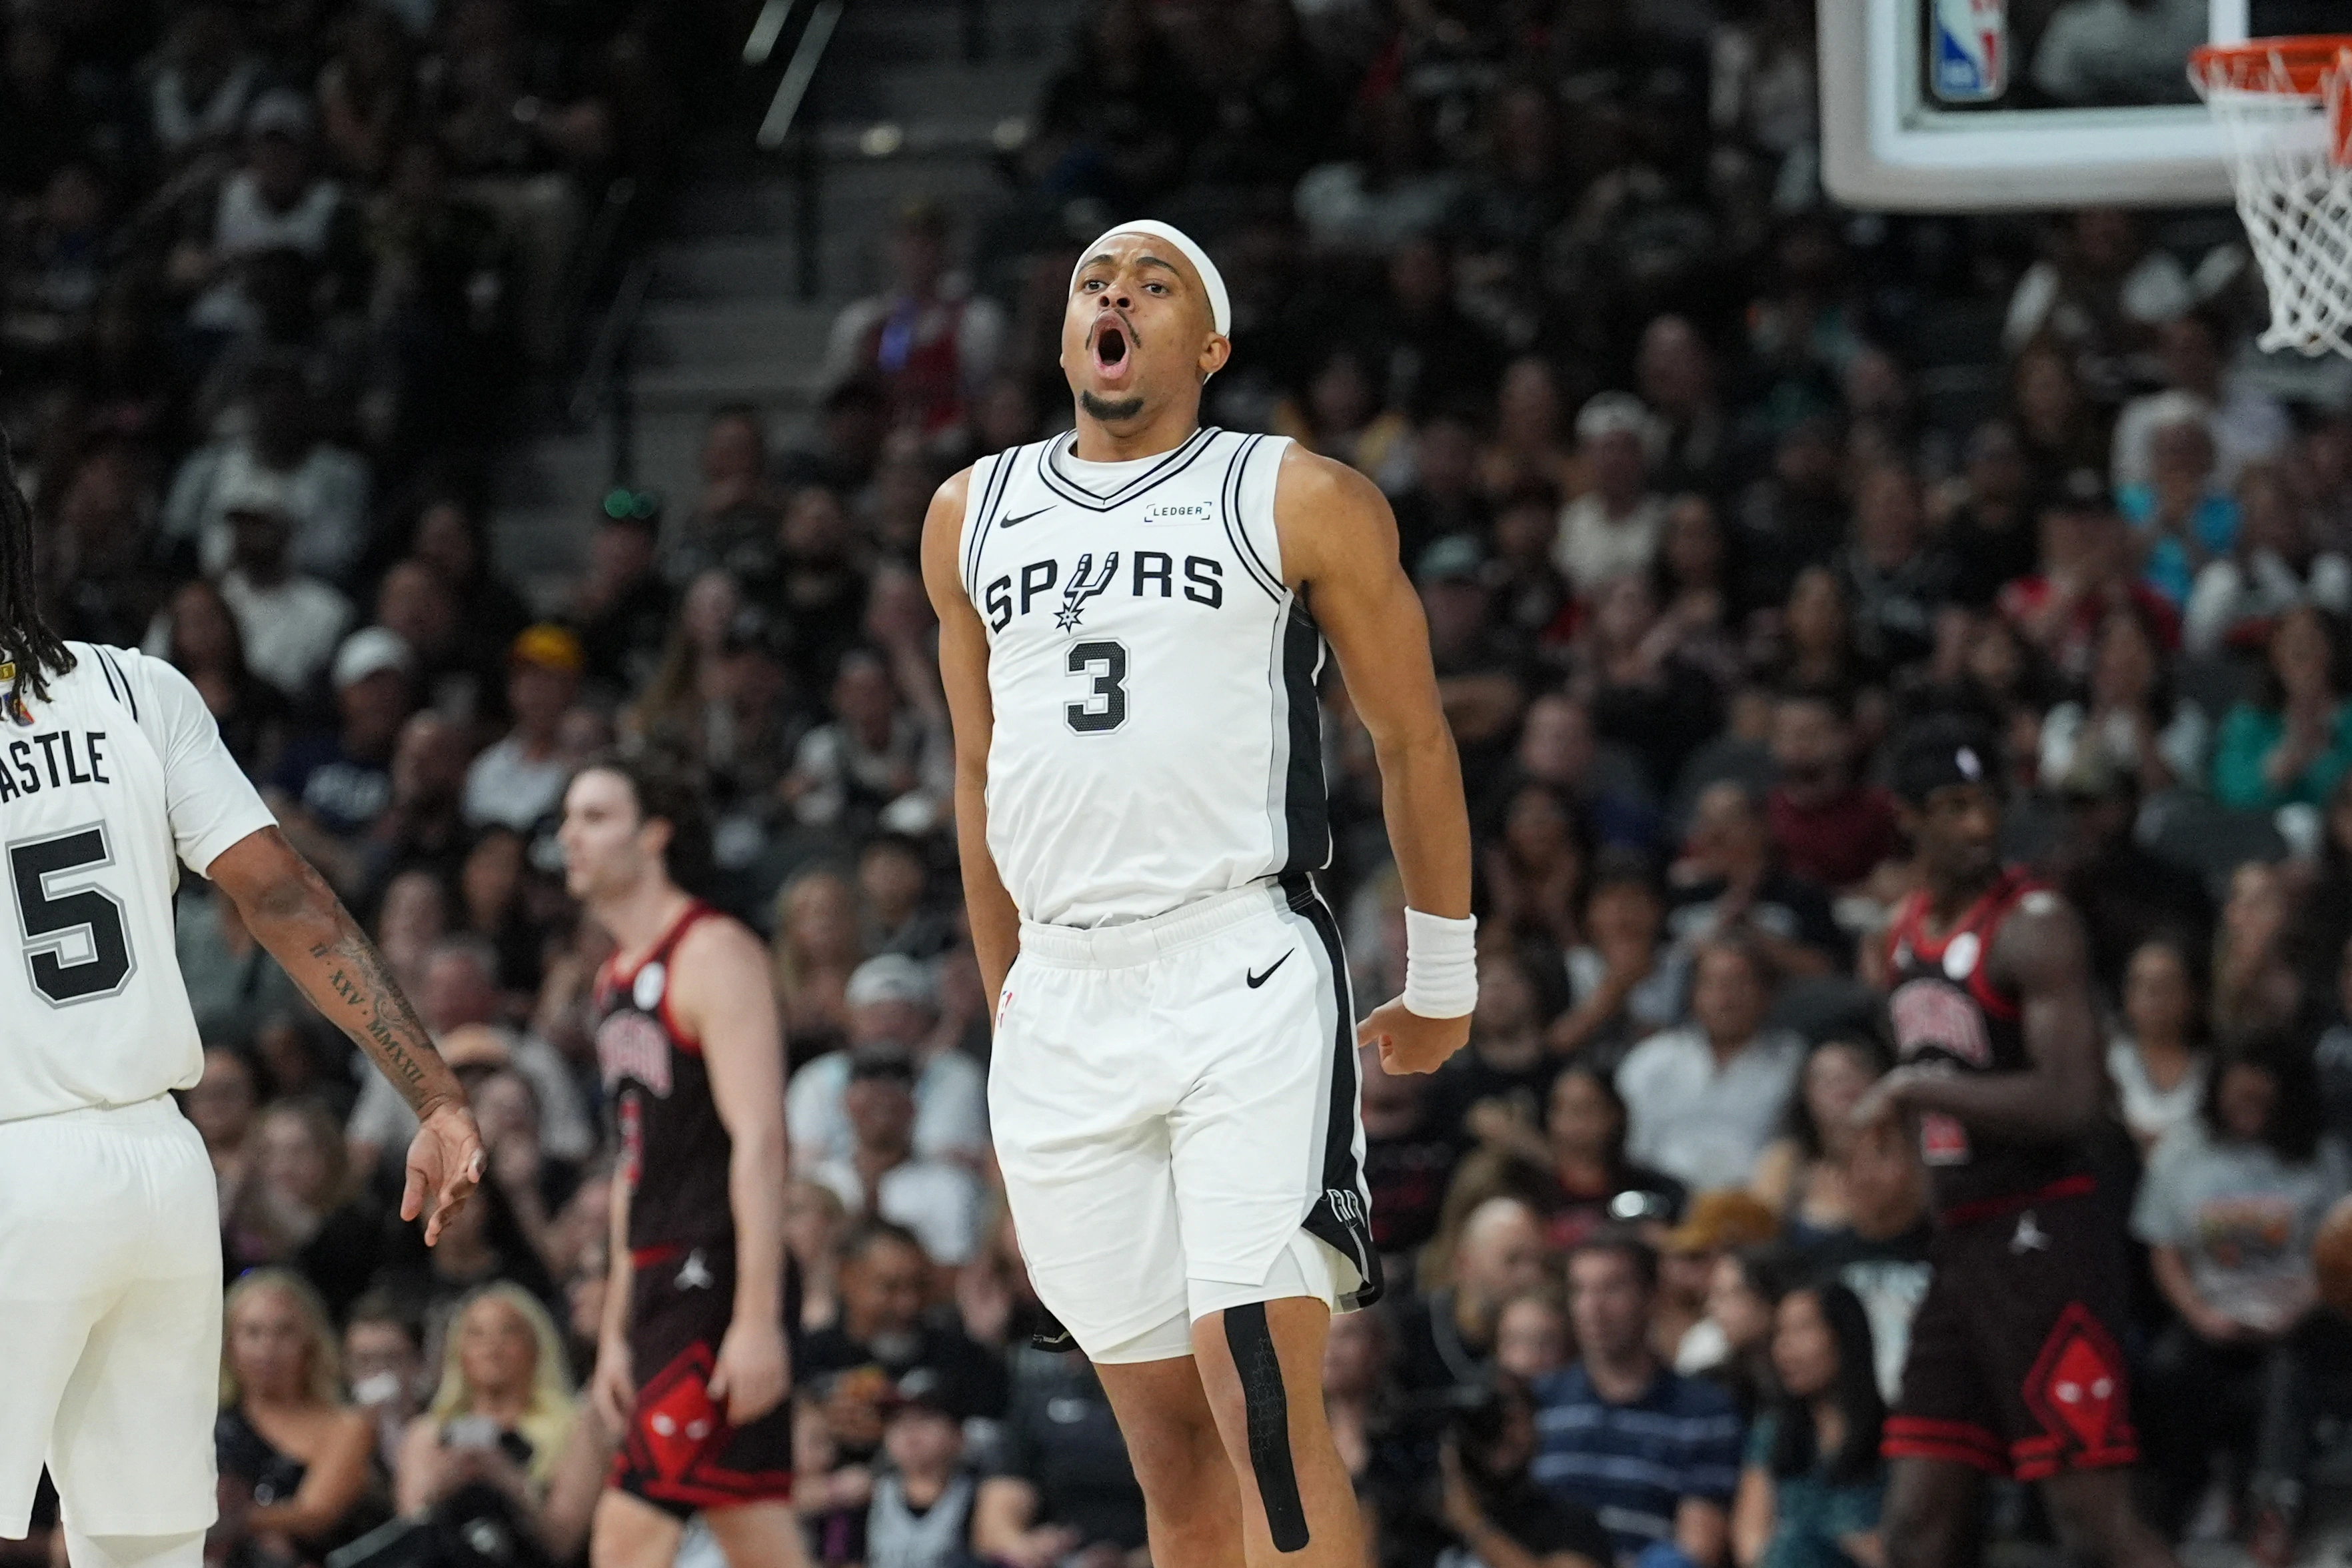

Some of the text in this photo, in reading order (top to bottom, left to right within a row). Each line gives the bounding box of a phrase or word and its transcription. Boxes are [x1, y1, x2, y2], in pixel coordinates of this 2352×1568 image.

[1152, 506, 1203, 516] LEDGER
[986, 550, 1223, 634] SPURS
[1064, 637, 1130, 736] 3
[5, 818, 138, 1010] 5
